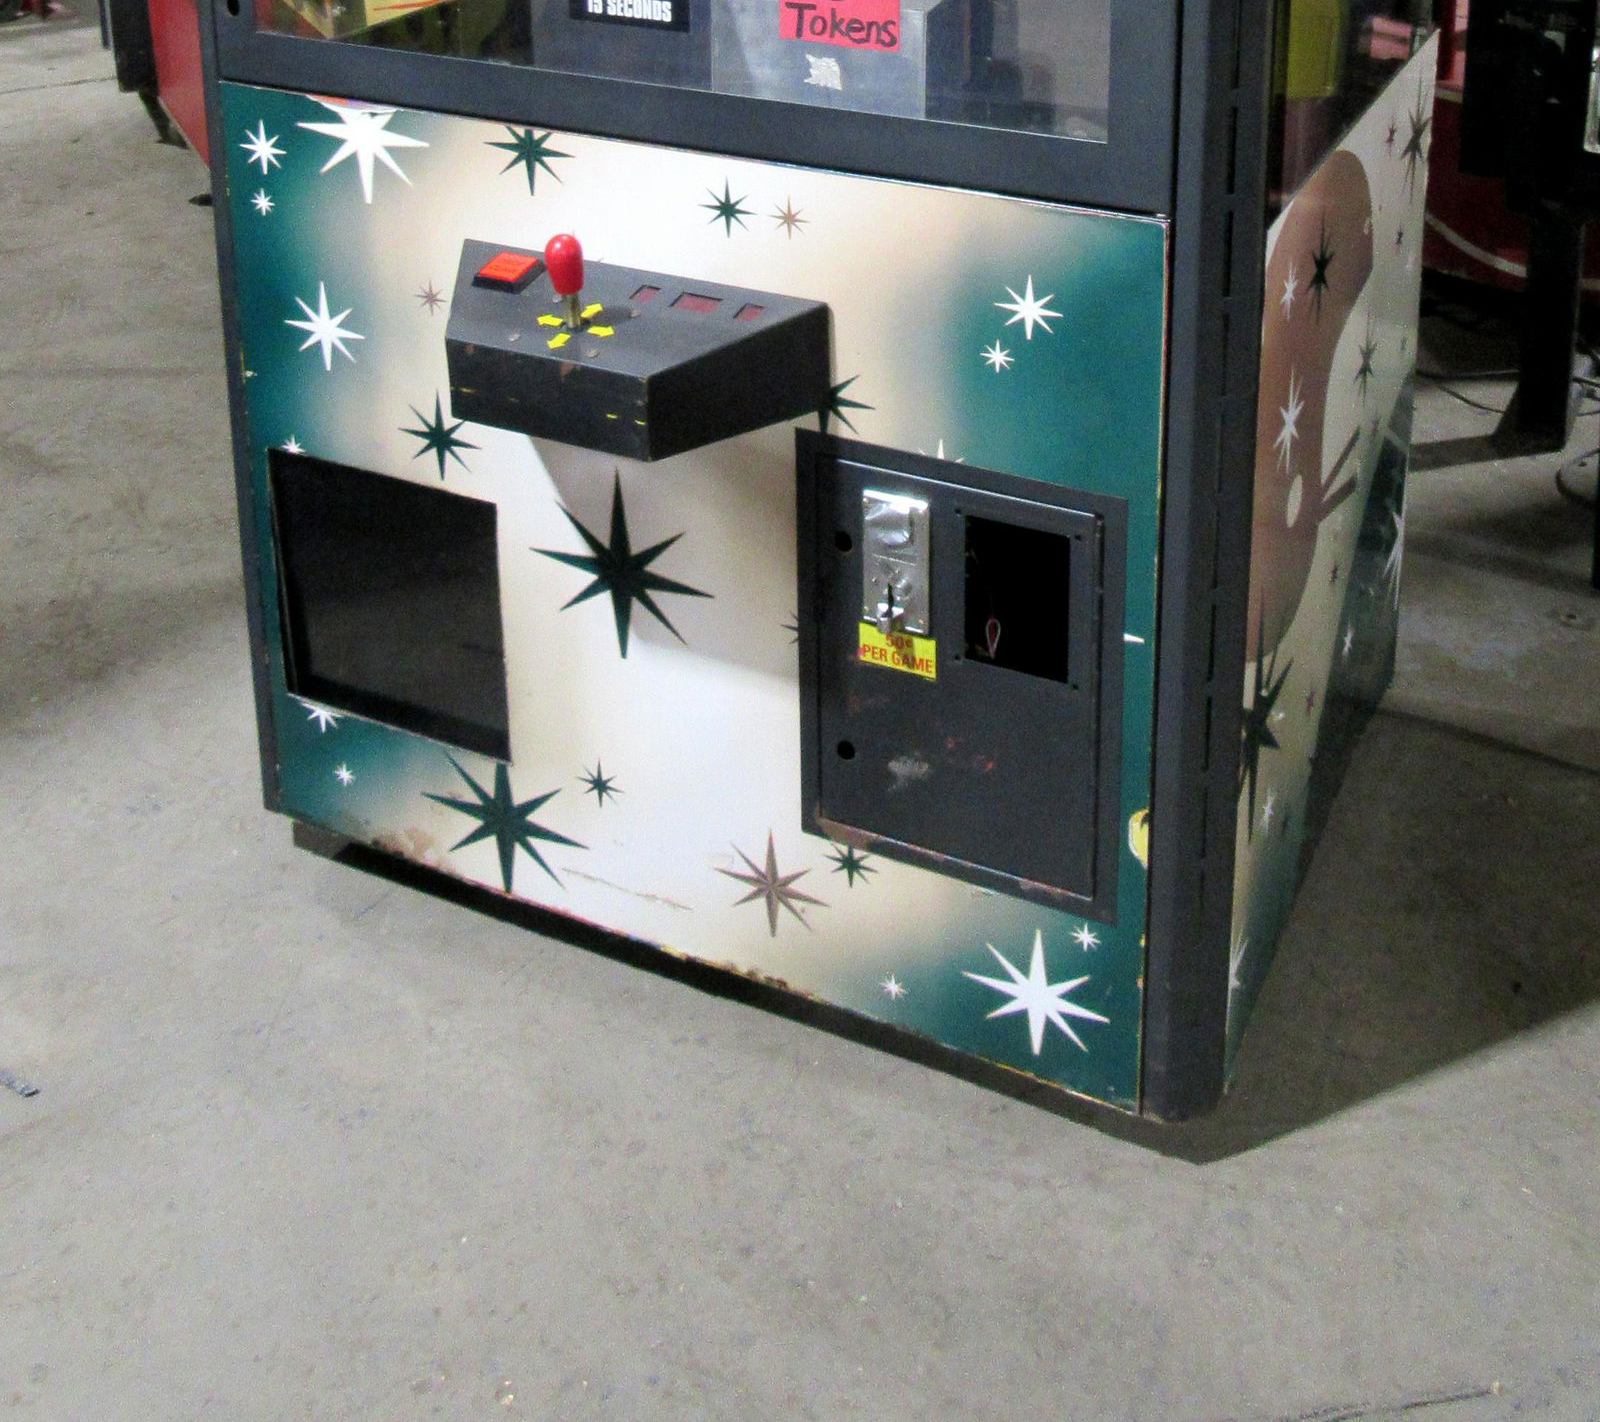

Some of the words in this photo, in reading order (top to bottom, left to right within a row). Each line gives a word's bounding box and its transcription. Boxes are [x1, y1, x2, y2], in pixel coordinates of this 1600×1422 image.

[784, 1, 898, 48] Tokens
[862, 643, 888, 662] PER
[891, 651, 933, 674] GAME
